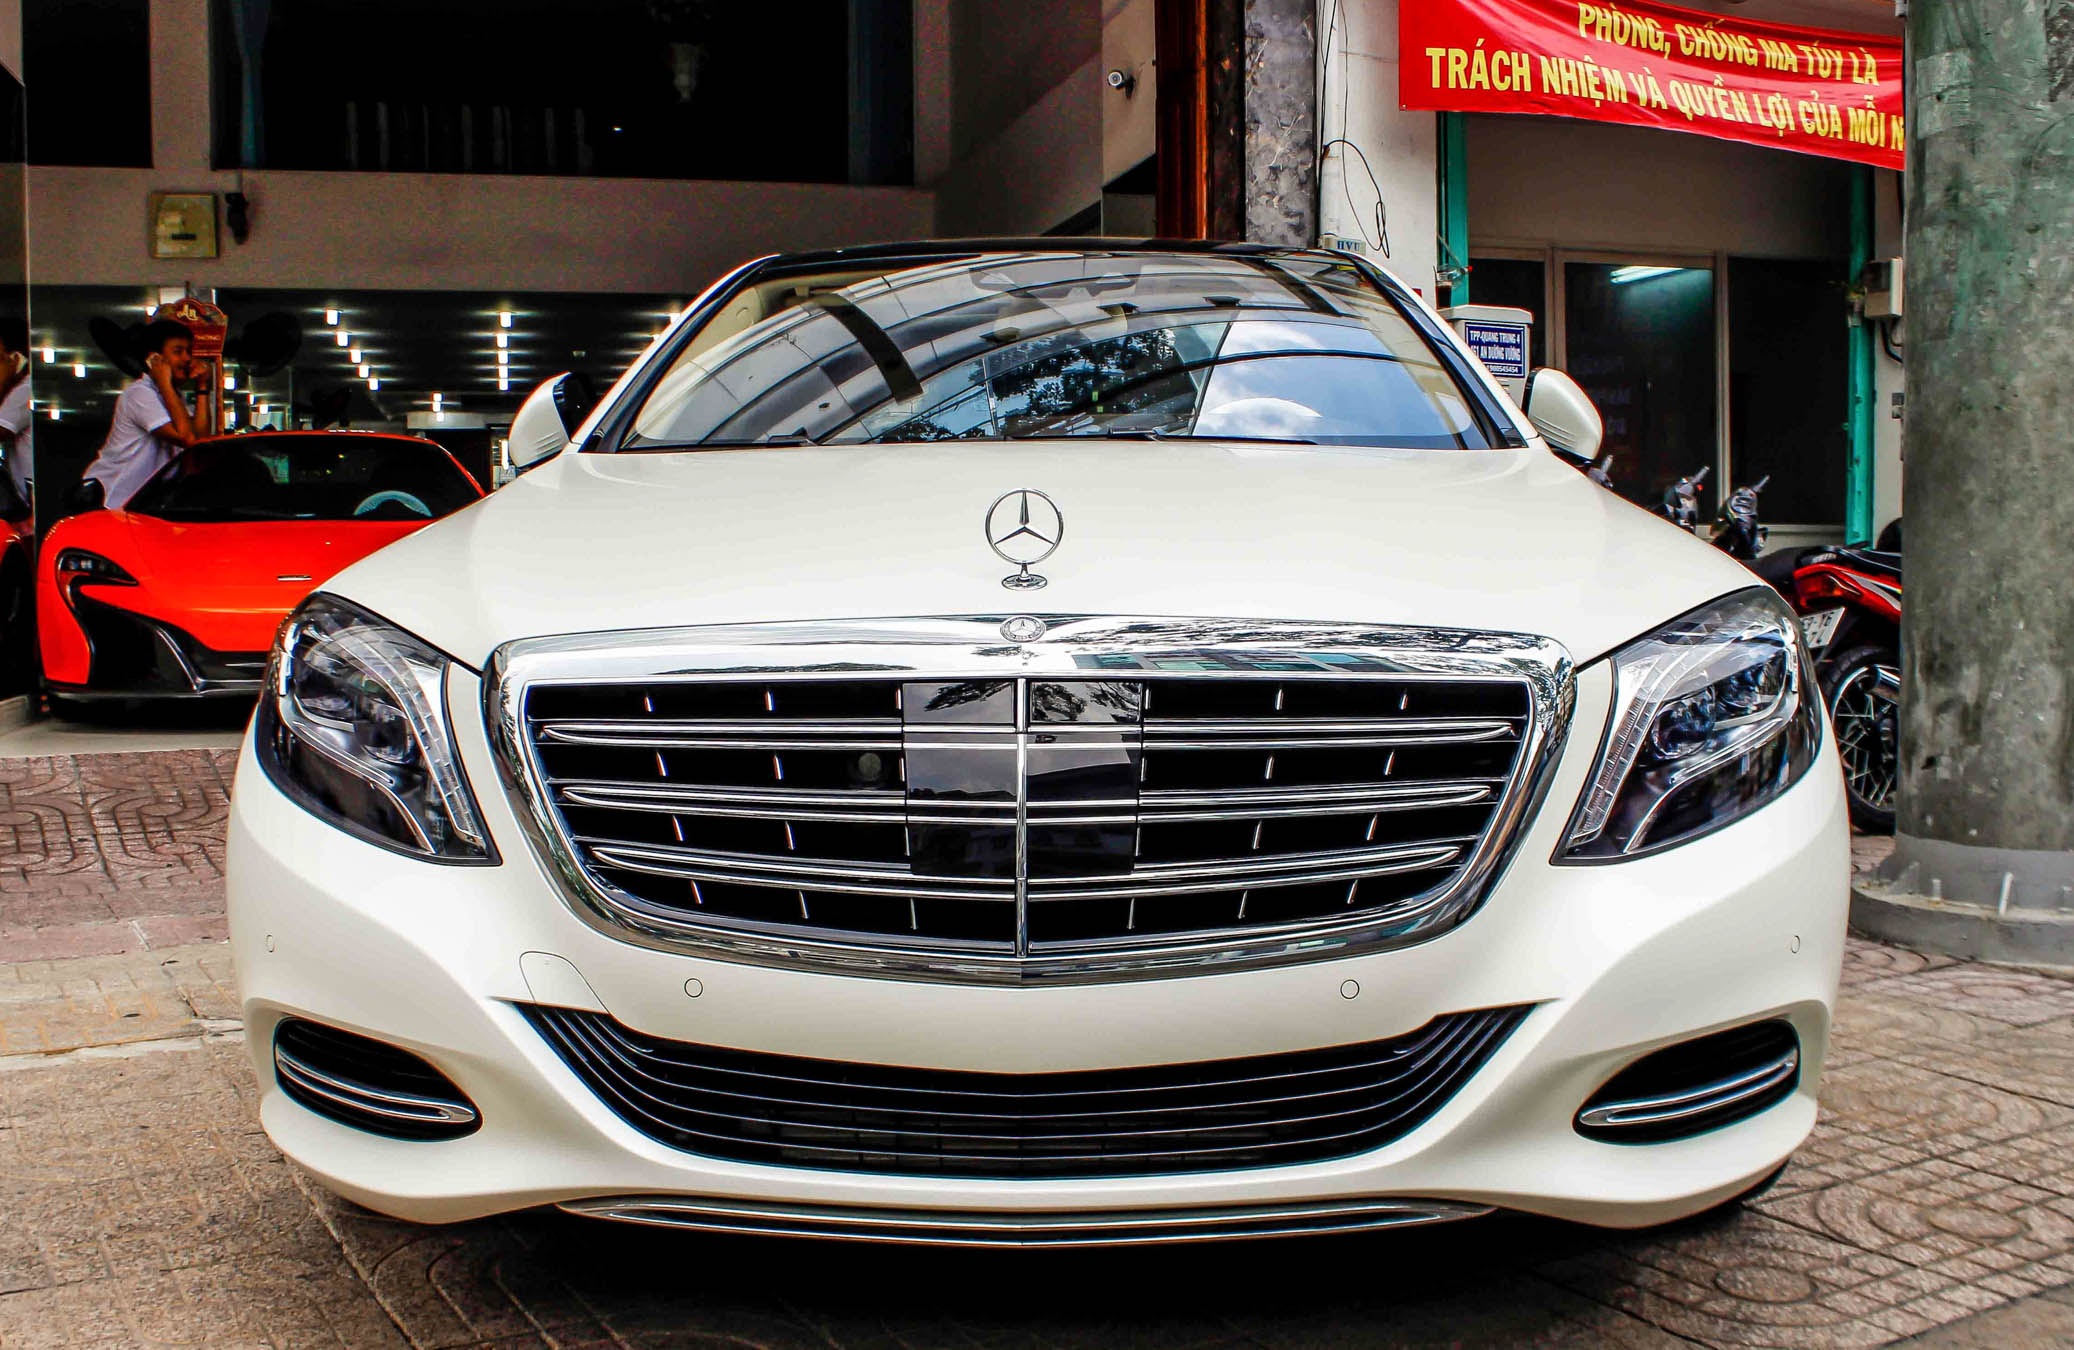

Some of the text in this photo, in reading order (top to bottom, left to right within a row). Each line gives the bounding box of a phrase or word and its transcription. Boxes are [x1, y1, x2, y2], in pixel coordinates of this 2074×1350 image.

[1578, 2, 1879, 86] PHÒNG, CHỐNG MA TÚY LÀ
[1425, 38, 1532, 92] TRÁCH
[1540, 54, 1628, 108] NHIỆM
[1628, 66, 1668, 110] VÀ
[1669, 74, 1753, 121] QUYỀN
[1752, 92, 1796, 137] LỢI
[1798, 90, 1843, 140] CỦA
[1847, 94, 1886, 147] MỖI
[1480, 345, 1488, 358] AN
[1499, 332, 1516, 344] TRUNG
